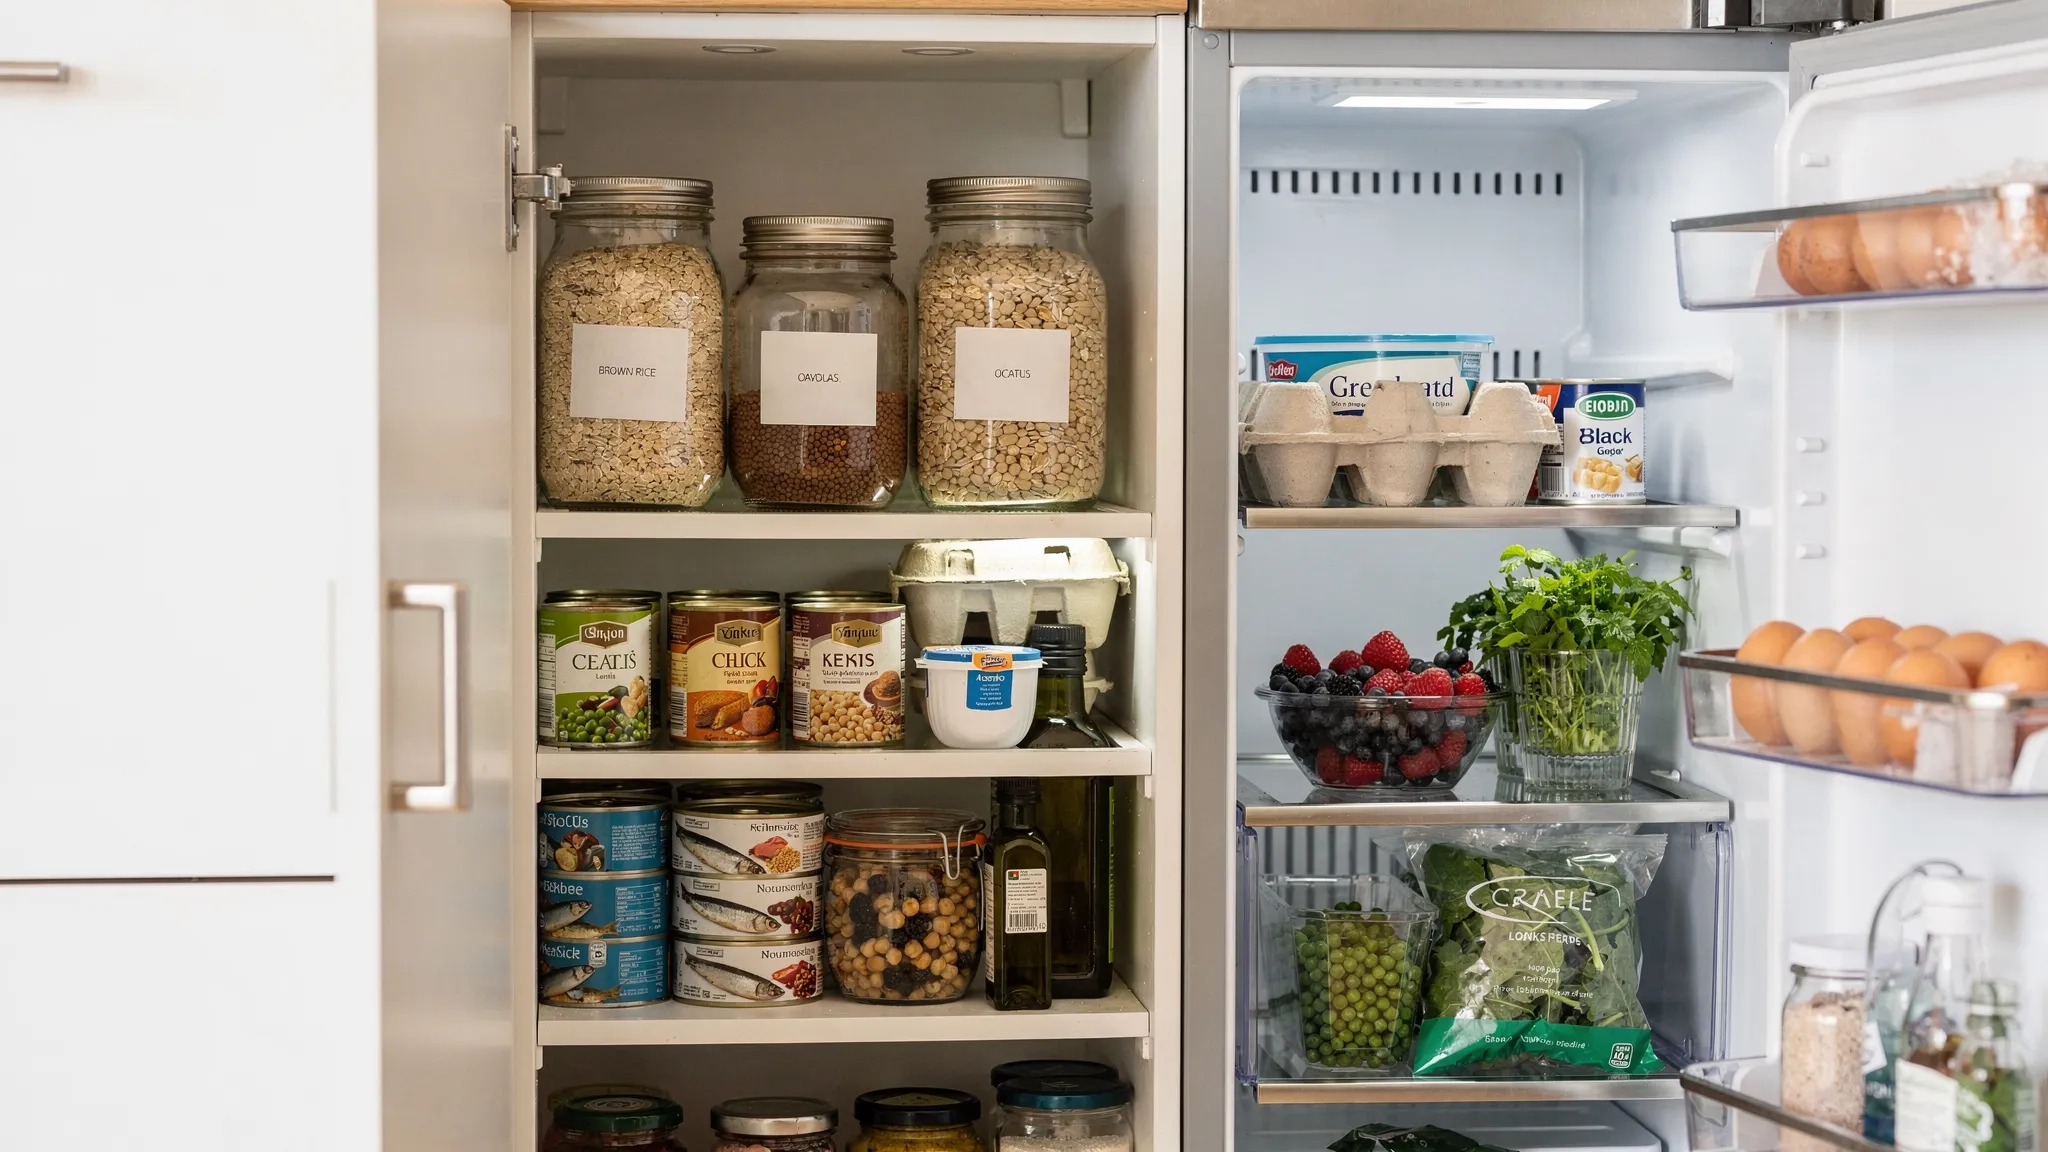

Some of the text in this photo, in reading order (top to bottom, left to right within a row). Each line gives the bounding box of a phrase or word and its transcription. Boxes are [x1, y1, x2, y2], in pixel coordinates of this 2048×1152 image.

[598, 365, 657, 378] BROWN RICE
[994, 368, 1031, 379] OCATUS
[1579, 428, 1633, 445] Black
